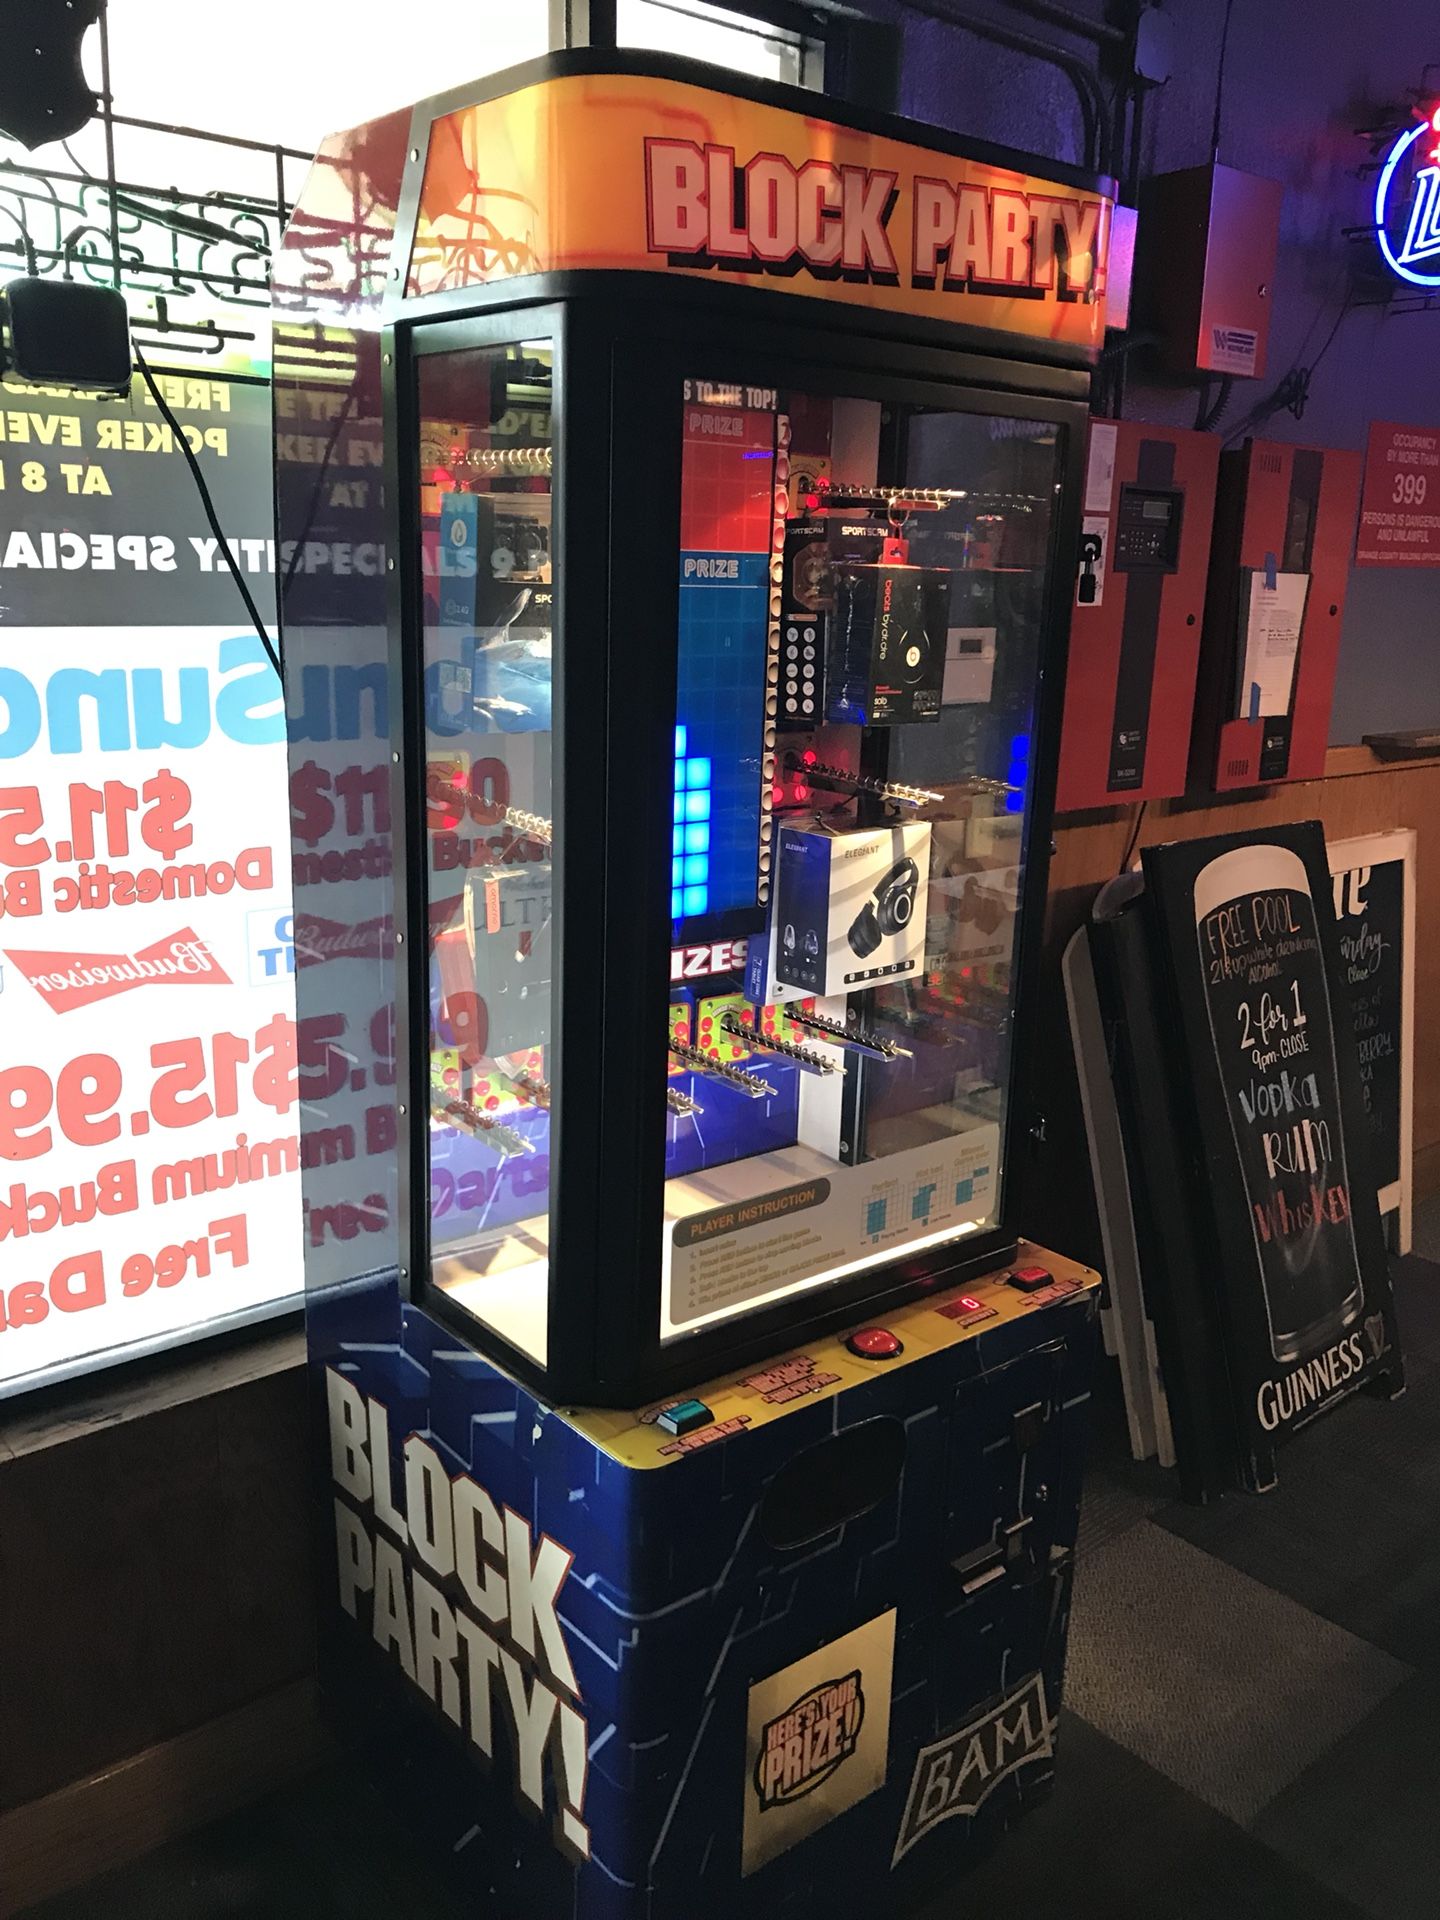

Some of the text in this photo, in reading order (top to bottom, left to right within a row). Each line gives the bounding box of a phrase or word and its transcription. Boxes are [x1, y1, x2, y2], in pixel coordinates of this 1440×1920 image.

[644, 137, 1111, 300] BLOCK PARTY!
[696, 382, 713, 403] TO
[718, 384, 742, 406] THE
[746, 388, 776, 410] TOP!
[690, 413, 744, 437] PRIZE
[1387, 449, 1439, 466] BY MORE THAN
[1392, 433, 1437, 450] OCCUPANCY
[1392, 473, 1427, 505] 399
[842, 526, 889, 537] SPORTSCAM
[1362, 511, 1440, 528] PERSONS IS DANGEROU
[1377, 529, 1429, 542] AND UNLAWFUL
[684, 558, 739, 579] PRIZE
[883, 579, 893, 612] beats
[882, 613, 891, 628] by
[1207, 895, 1300, 974] FREE POOL
[1238, 980, 1307, 1049] 2 for 1
[690, 1189, 816, 1238] PLAYER INSTRUCTION
[1257, 1331, 1364, 1431] GUINNESS
[326, 1365, 582, 1703] BLOCK
[334, 1497, 591, 1859] PARTY!
[767, 1679, 857, 1752] HERE'S YOUR
[765, 1702, 855, 1801] PRIZE!
